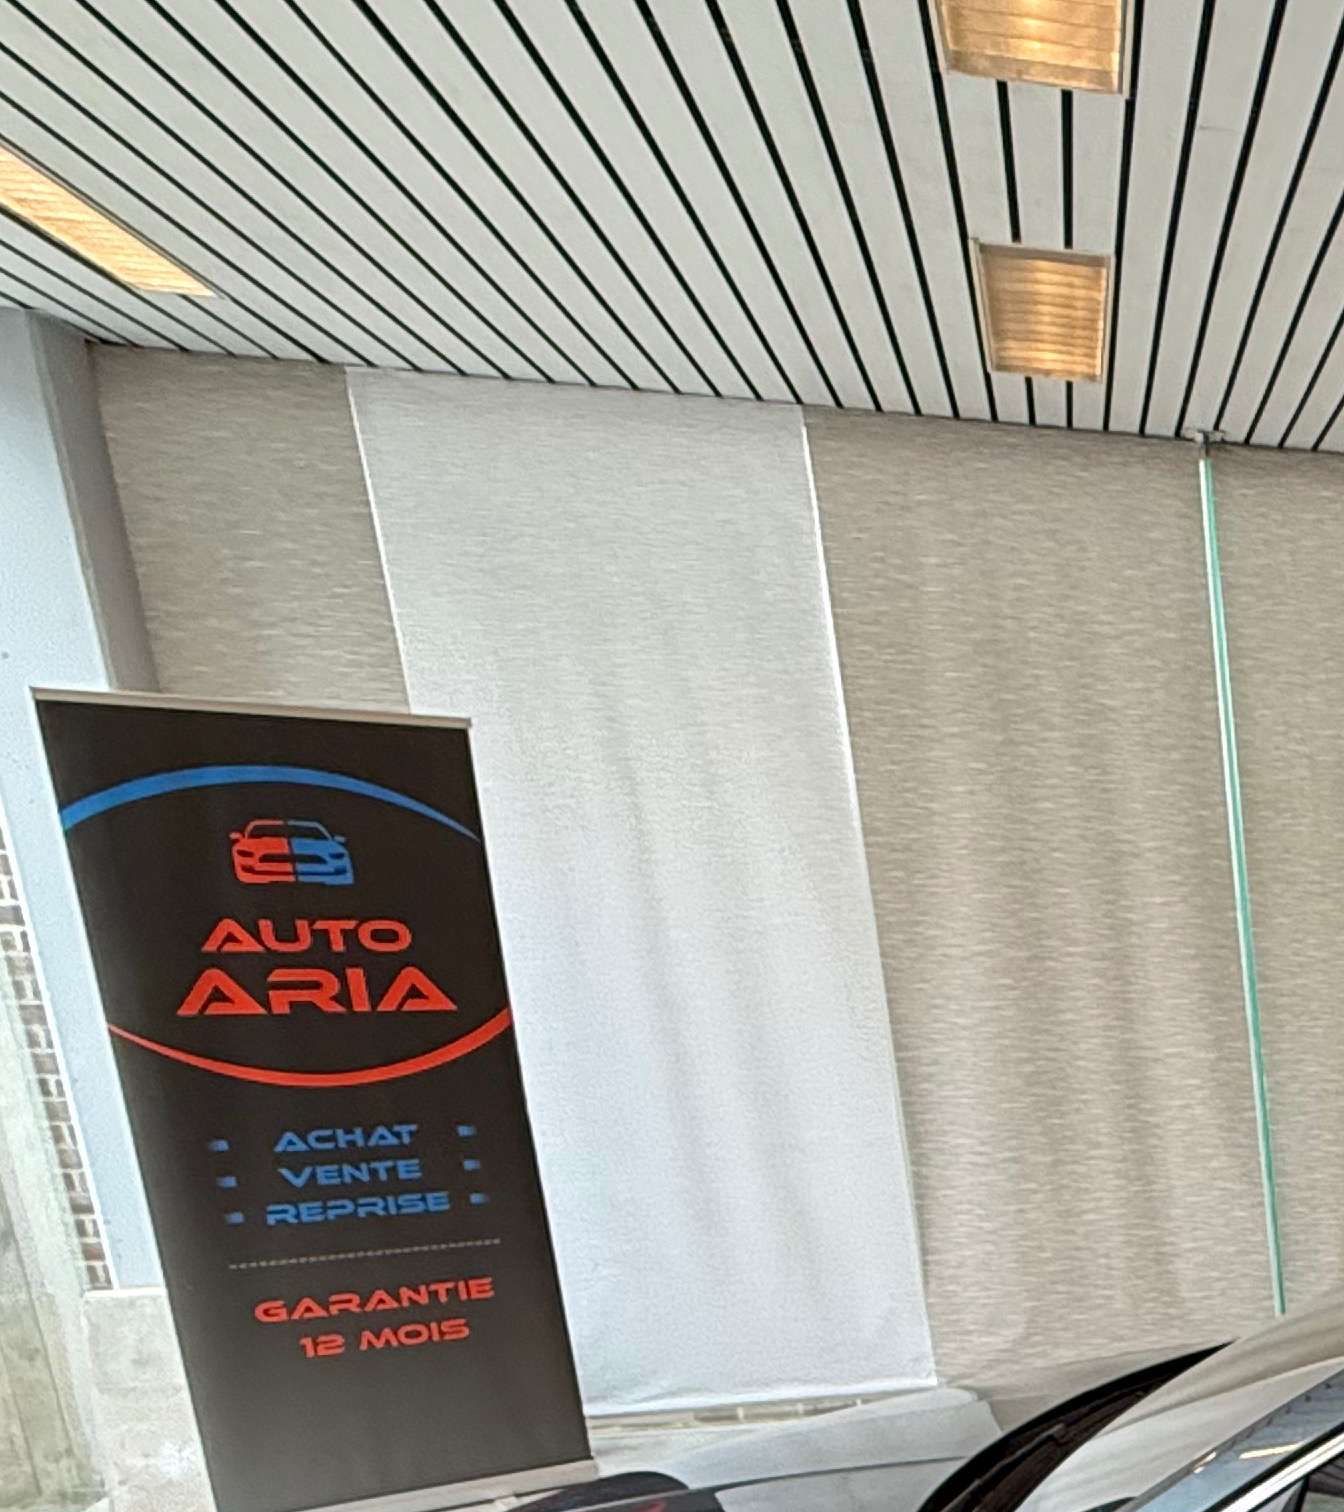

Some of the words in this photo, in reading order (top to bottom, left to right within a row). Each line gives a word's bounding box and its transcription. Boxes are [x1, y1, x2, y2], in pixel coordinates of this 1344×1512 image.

[202, 917, 413, 954] AUTO
[176, 966, 458, 1017] ARIA
[273, 1124, 418, 1153] ACHAT
[277, 1159, 422, 1188] VENTE
[265, 1191, 450, 1226] REPRISE
[254, 1277, 495, 1324] GARANTIE
[299, 1333, 345, 1358] 12
[359, 1318, 470, 1351] MOIS
